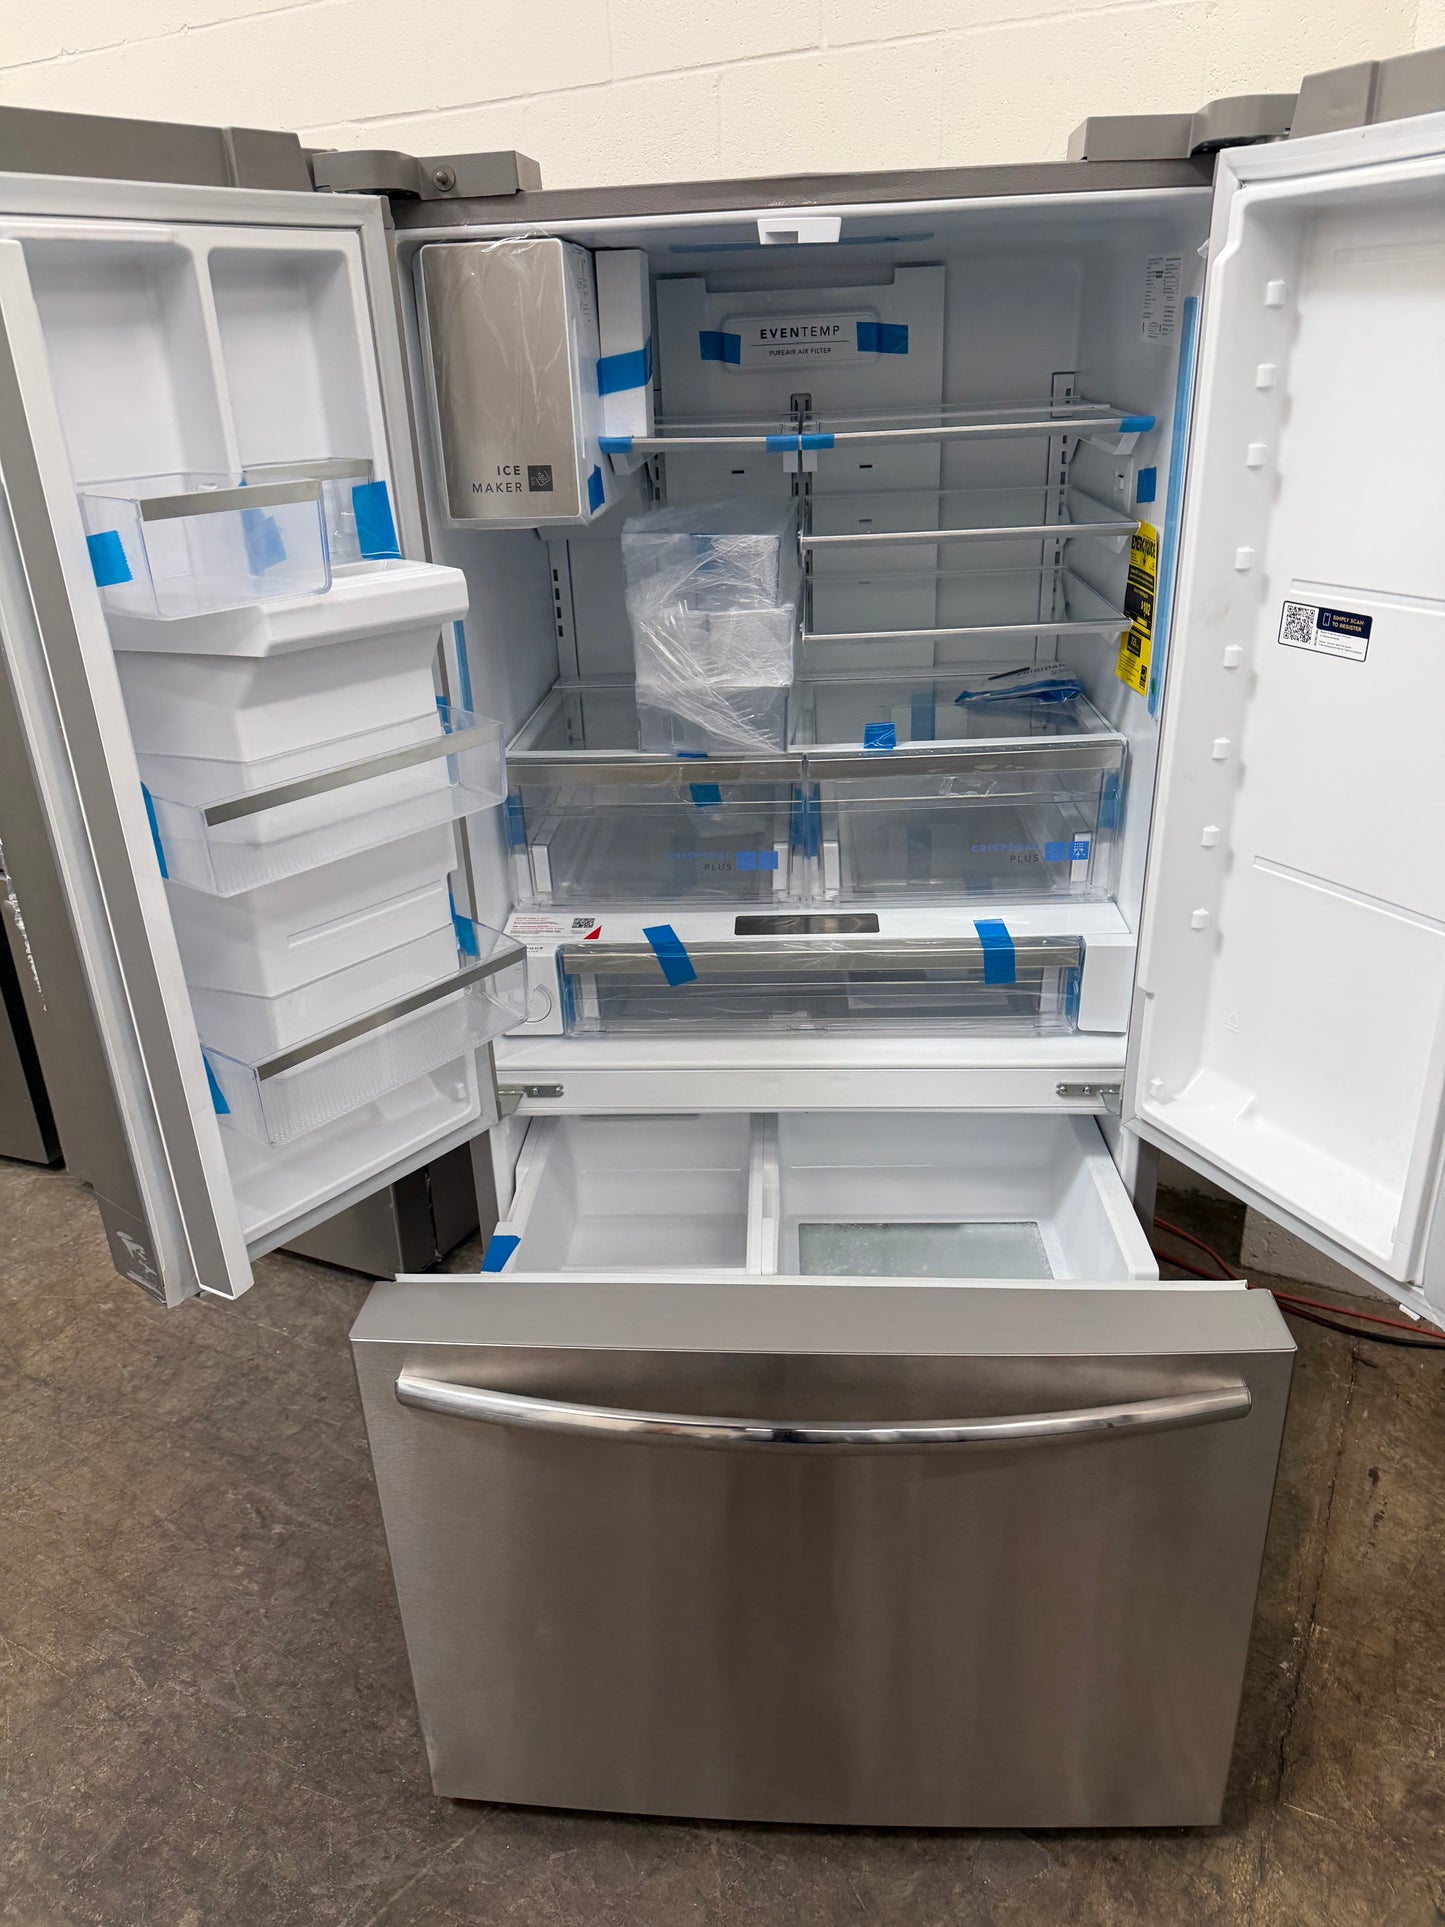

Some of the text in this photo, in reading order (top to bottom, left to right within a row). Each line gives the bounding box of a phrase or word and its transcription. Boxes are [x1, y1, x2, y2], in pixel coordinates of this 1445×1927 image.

[760, 325, 840, 340] EVENTEMP
[769, 346, 832, 356] PUREAIR AIR FILTER
[497, 465, 521, 476] ICE
[472, 482, 523, 494] MAKER
[1332, 614, 1365, 626] SIMPLY SCAN
[1339, 622, 1362, 632] REGISTER
[1009, 854, 1040, 863] PLUS
[703, 863, 732, 872] PLUS
